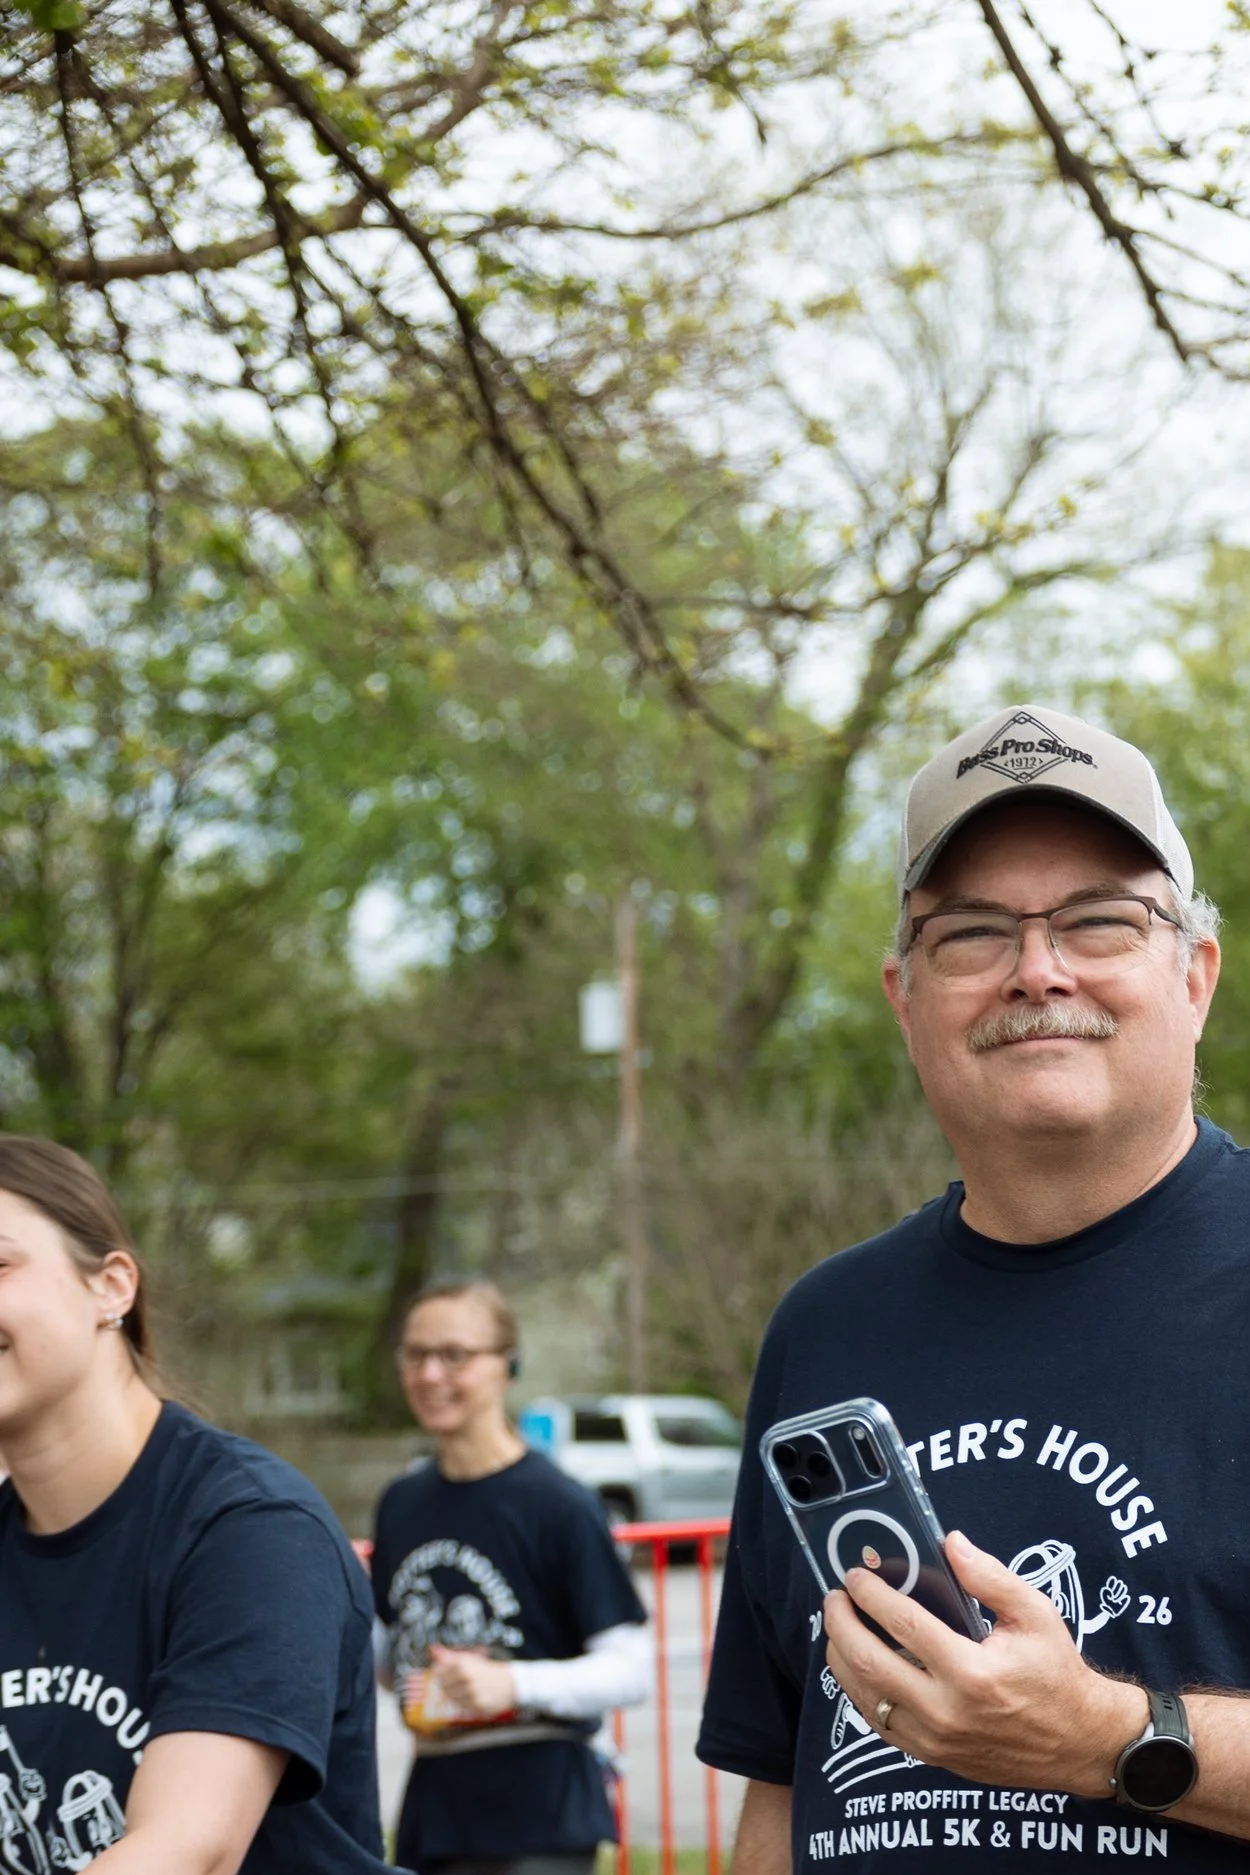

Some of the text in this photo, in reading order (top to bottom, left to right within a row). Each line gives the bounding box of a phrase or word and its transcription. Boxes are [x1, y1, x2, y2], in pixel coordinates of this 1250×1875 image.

[956, 738, 1093, 779] Bass Pro Shops
[1011, 757, 1037, 768] 1972
[1036, 1424, 1169, 1559] HOUSE
[1136, 1595, 1173, 1625] 26
[68, 1668, 150, 1765] HOU
[845, 1790, 1069, 1819] STEVE PROFFITT LEGACY
[809, 1818, 1168, 1860] 4TH ANNUAL 5K & FUN RUN
